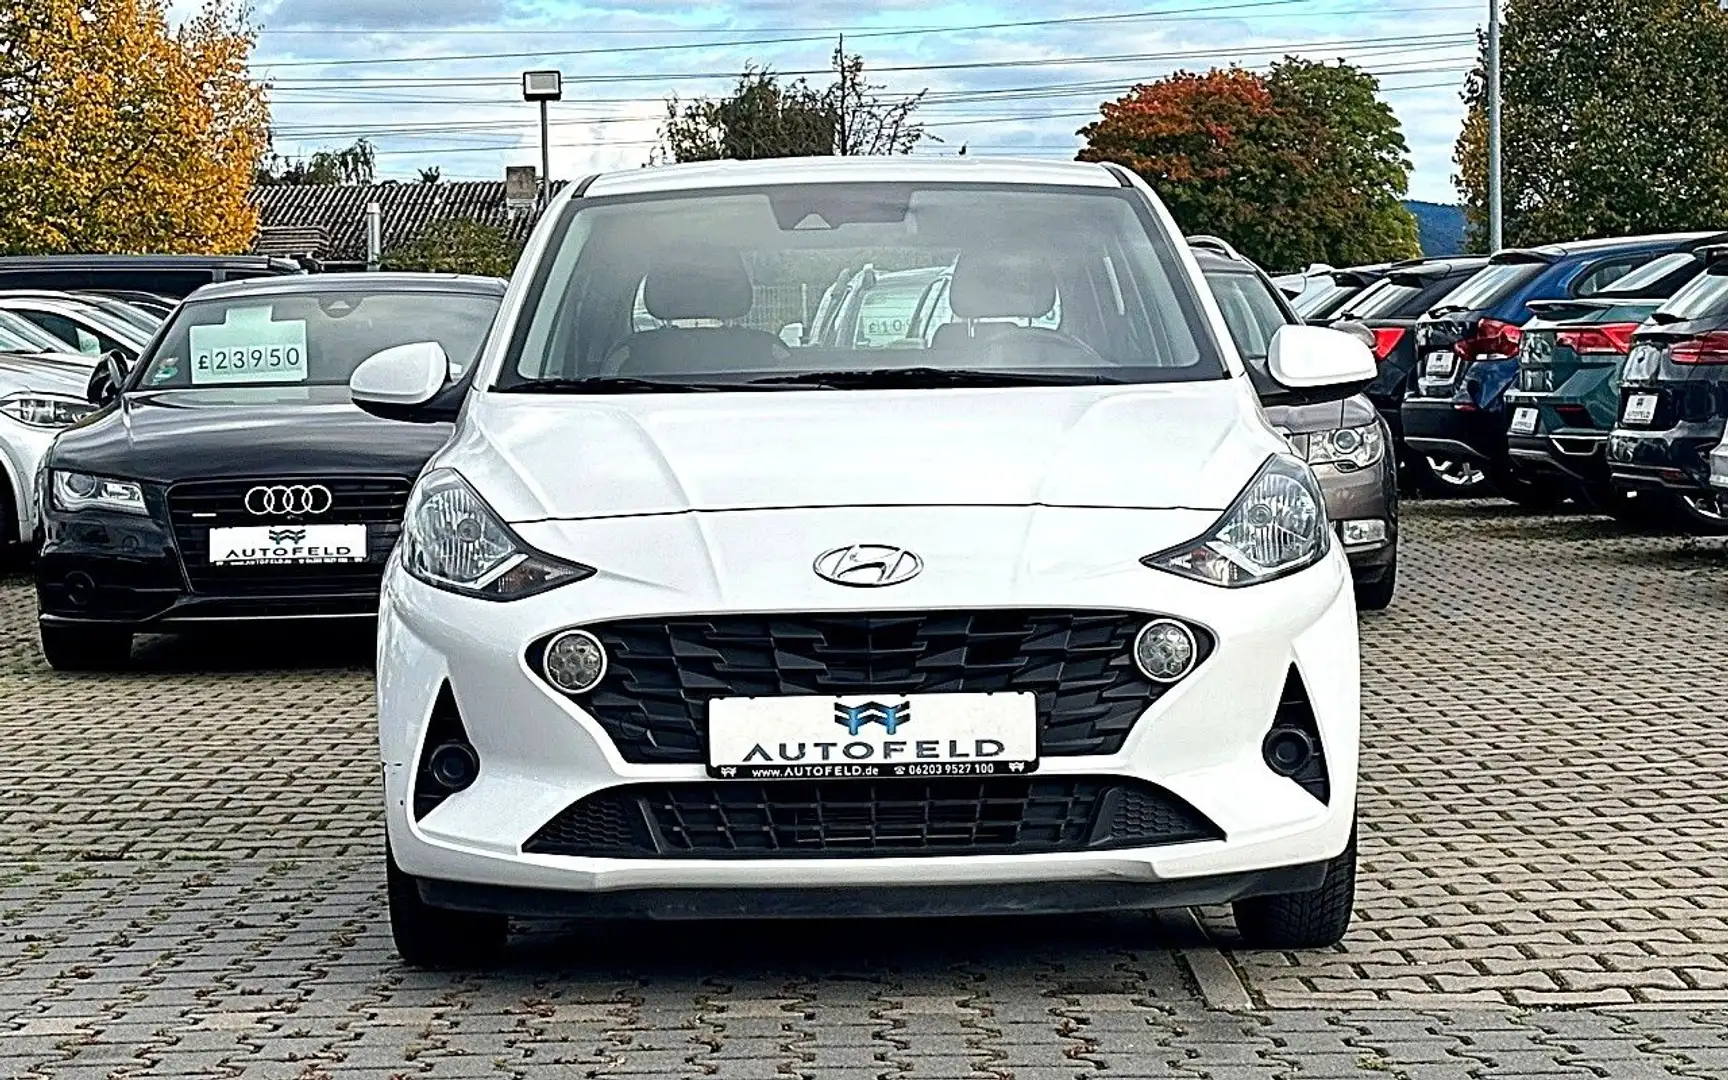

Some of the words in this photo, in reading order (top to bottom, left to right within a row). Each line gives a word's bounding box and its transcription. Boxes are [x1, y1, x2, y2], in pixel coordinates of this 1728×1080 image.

[198, 347, 300, 370] £23950
[225, 546, 352, 559] AUTOFELD
[742, 739, 1006, 763] AUTOFELD
[751, 765, 879, 778] www.AUTOFELD.de
[908, 764, 942, 775] 06203
[944, 763, 971, 774] 9527
[974, 762, 994, 774] 100
